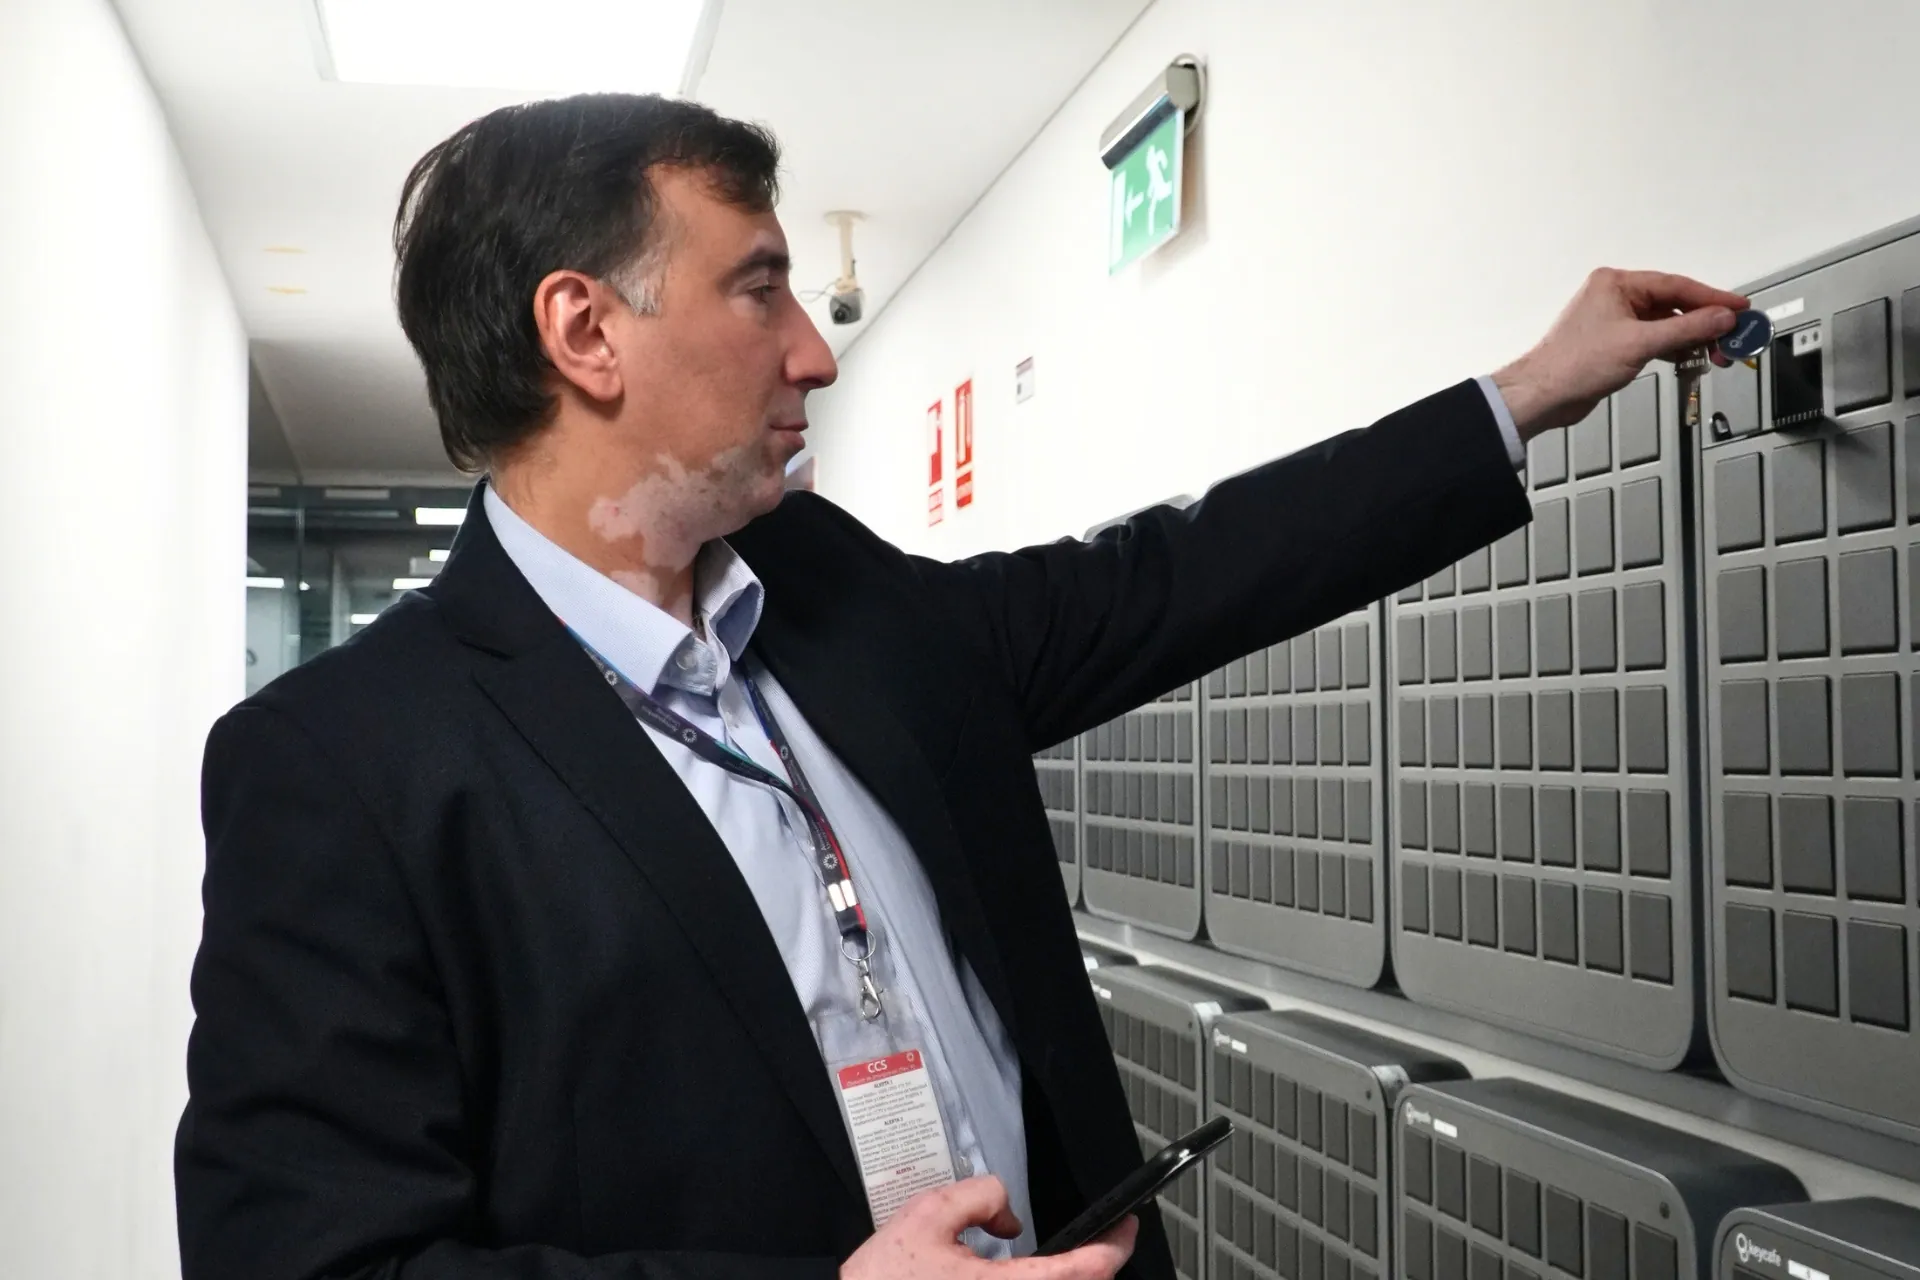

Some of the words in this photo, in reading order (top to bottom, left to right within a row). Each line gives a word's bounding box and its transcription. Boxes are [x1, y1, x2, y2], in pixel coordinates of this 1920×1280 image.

[867, 1059, 888, 1073] CCS
[884, 1117, 900, 1125] ALERTA
[896, 1167, 912, 1175] ALERTA
[1748, 1239, 1781, 1267] keycafe
